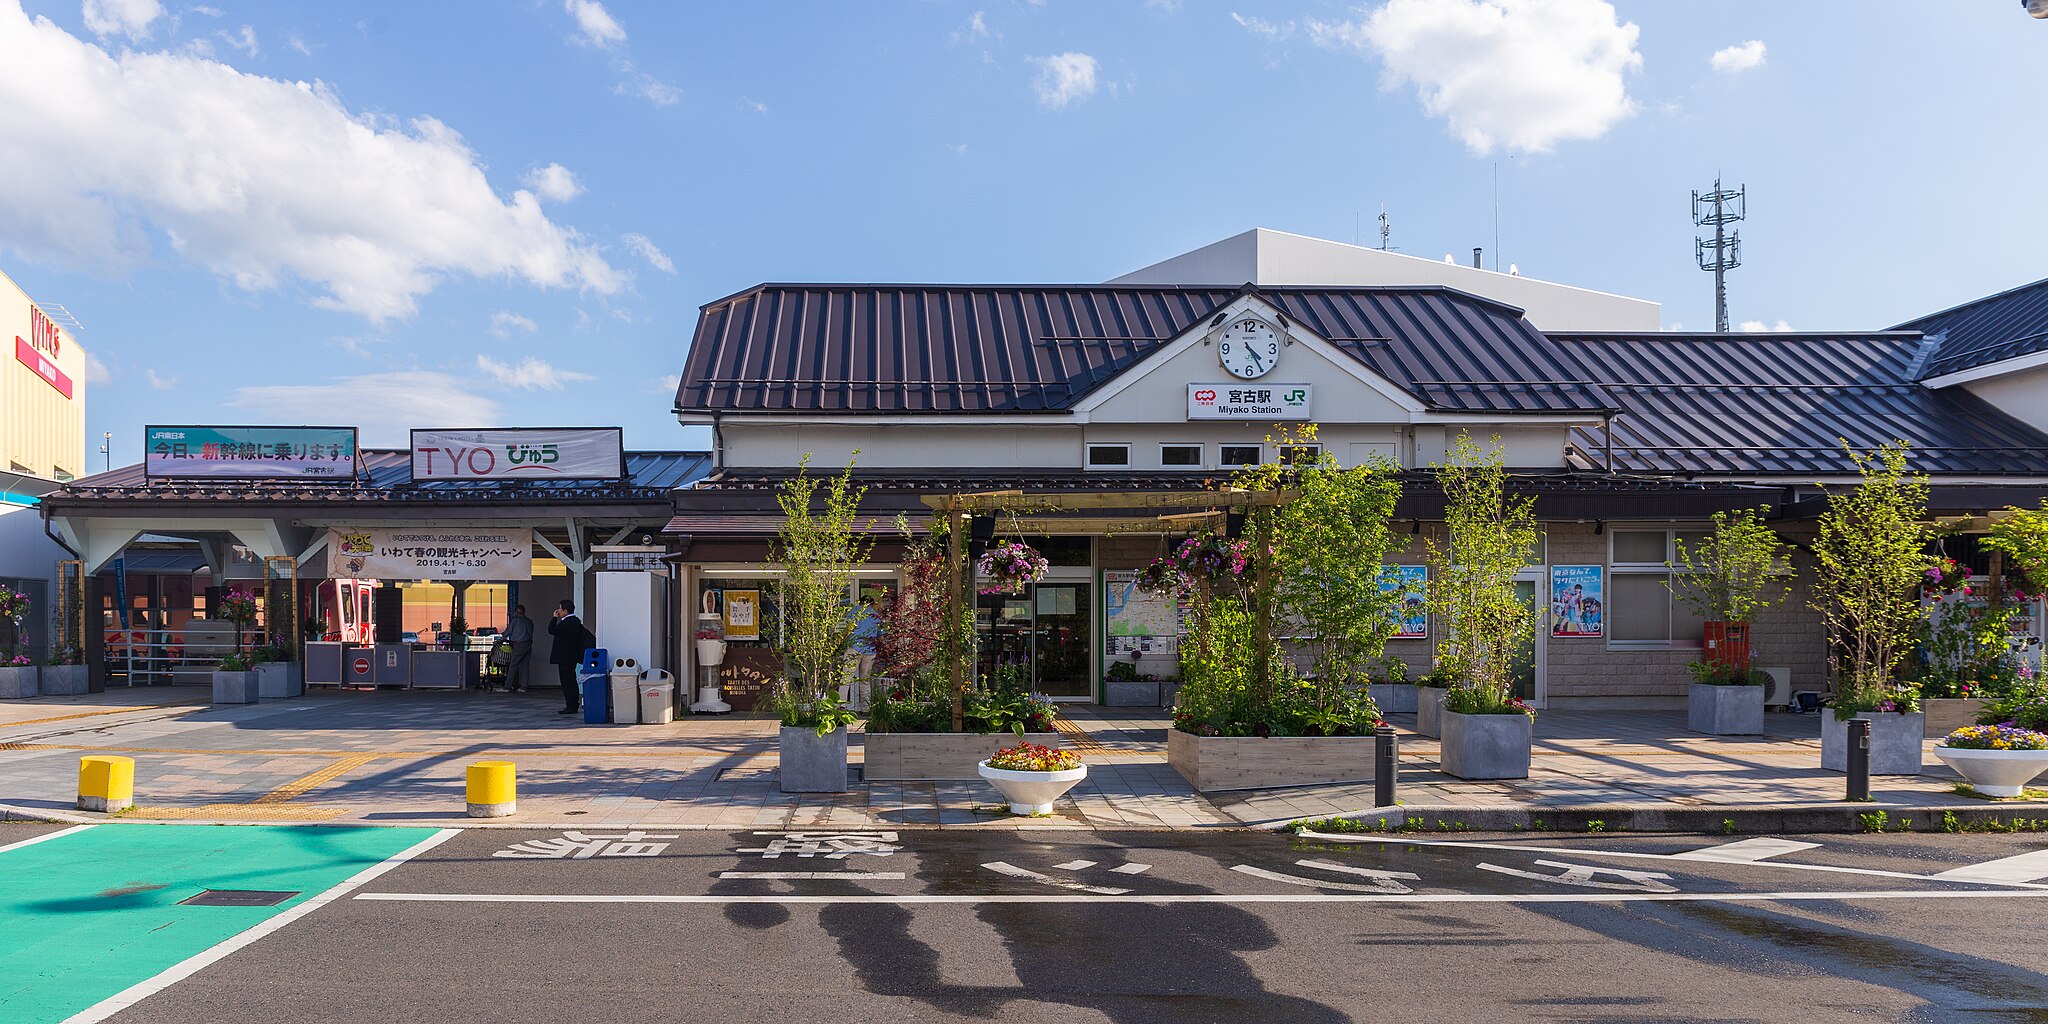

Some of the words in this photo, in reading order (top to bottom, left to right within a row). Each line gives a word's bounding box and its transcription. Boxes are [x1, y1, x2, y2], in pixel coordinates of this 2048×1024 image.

[31, 304, 60, 360] WINS
[1243, 320, 1256, 332] 12
[1221, 343, 1230, 355] 9
[1268, 343, 1277, 355] 3
[1245, 364, 1254, 376] 6
[1228, 389, 1271, 404] 宮古駅
[1283, 389, 1306, 402] JR
[1218, 405, 1250, 416] Miyako
[1251, 405, 1282, 414] Station
[151, 431, 186, 440] JR東日本
[154, 441, 351, 462] 今日、新幹線に乗ります。
[505, 444, 560, 464] びゅう
[417, 447, 496, 475] TYO
[381, 547, 522, 558] いわて春の観光キャンペーン
[1404, 624, 1425, 632] TYO
[1579, 622, 1600, 631] TYO
